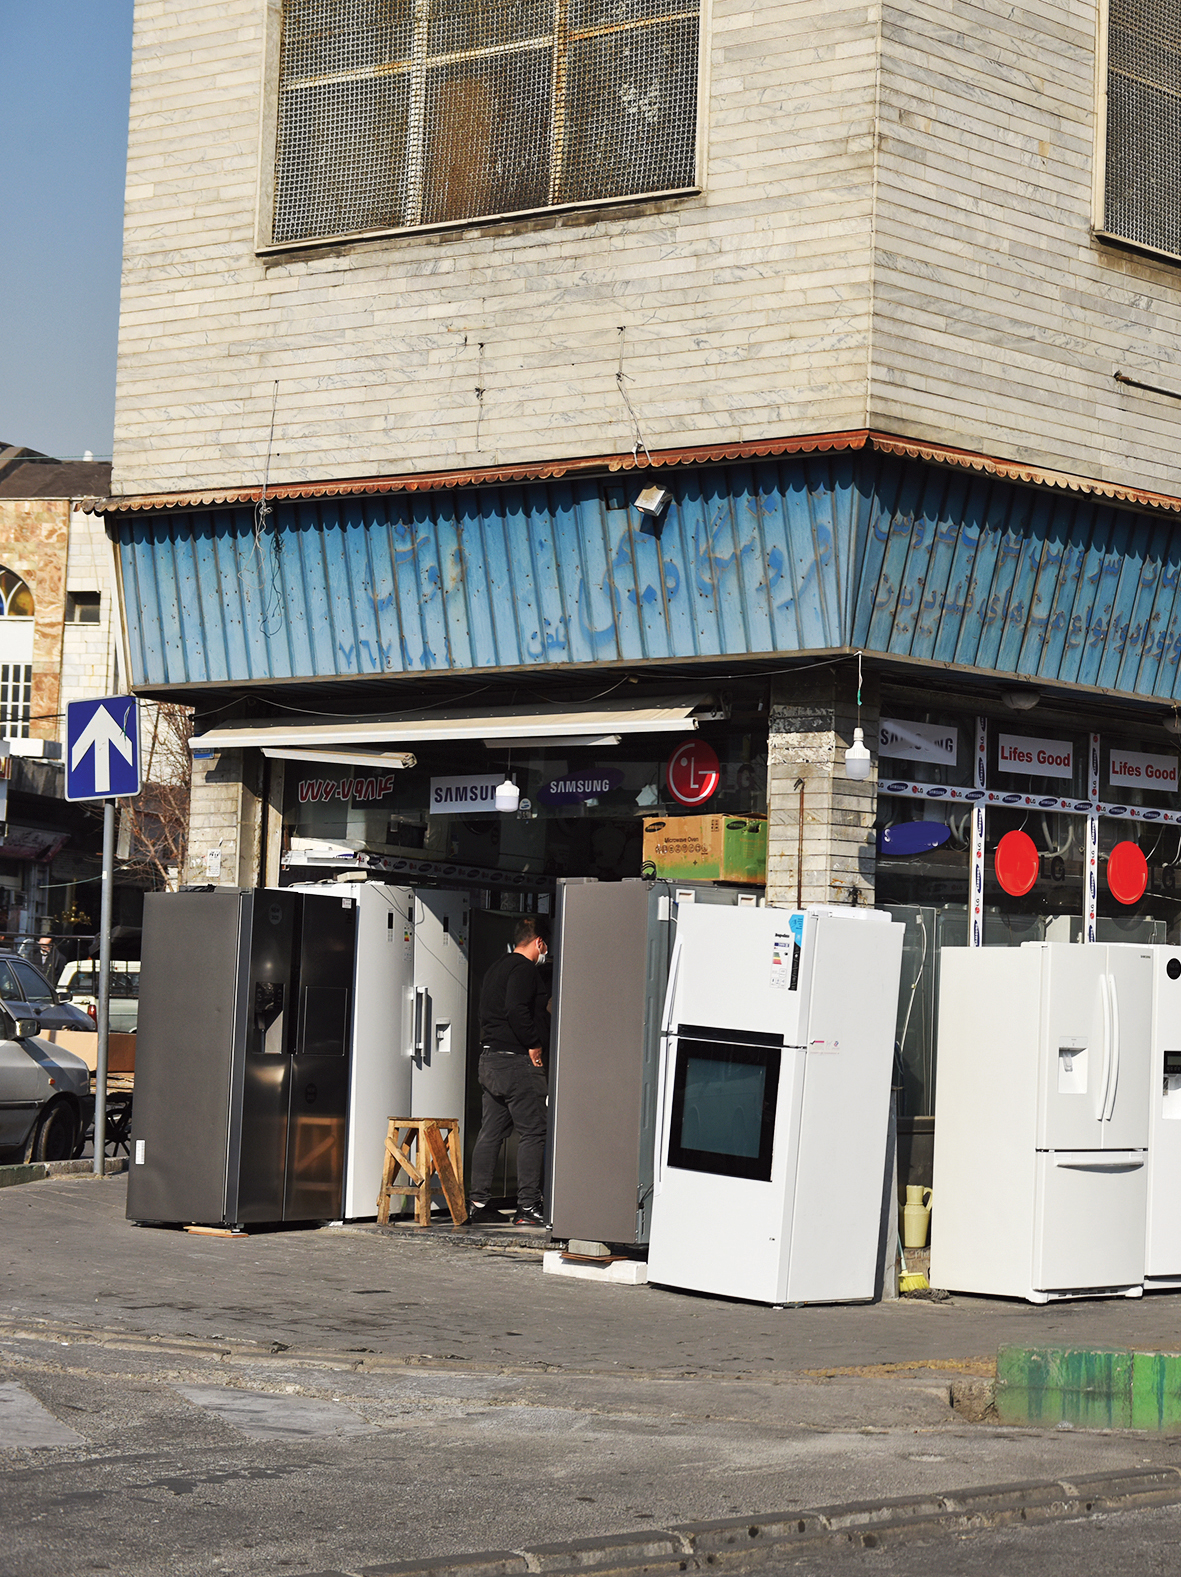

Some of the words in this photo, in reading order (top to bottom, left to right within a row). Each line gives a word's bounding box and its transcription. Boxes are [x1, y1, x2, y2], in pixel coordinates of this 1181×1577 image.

[526, 614, 571, 661] تلفن
[880, 728, 953, 753] SANG
[1000, 745, 1033, 763] Lifes
[1037, 750, 1071, 767] Good
[1112, 760, 1142, 777] Lifes
[1145, 764, 1176, 781] Good
[434, 785, 497, 803] SAMSU
[550, 779, 610, 794] SAMSUNG
[1040, 855, 1065, 881] LG
[1151, 865, 1175, 890] LG
